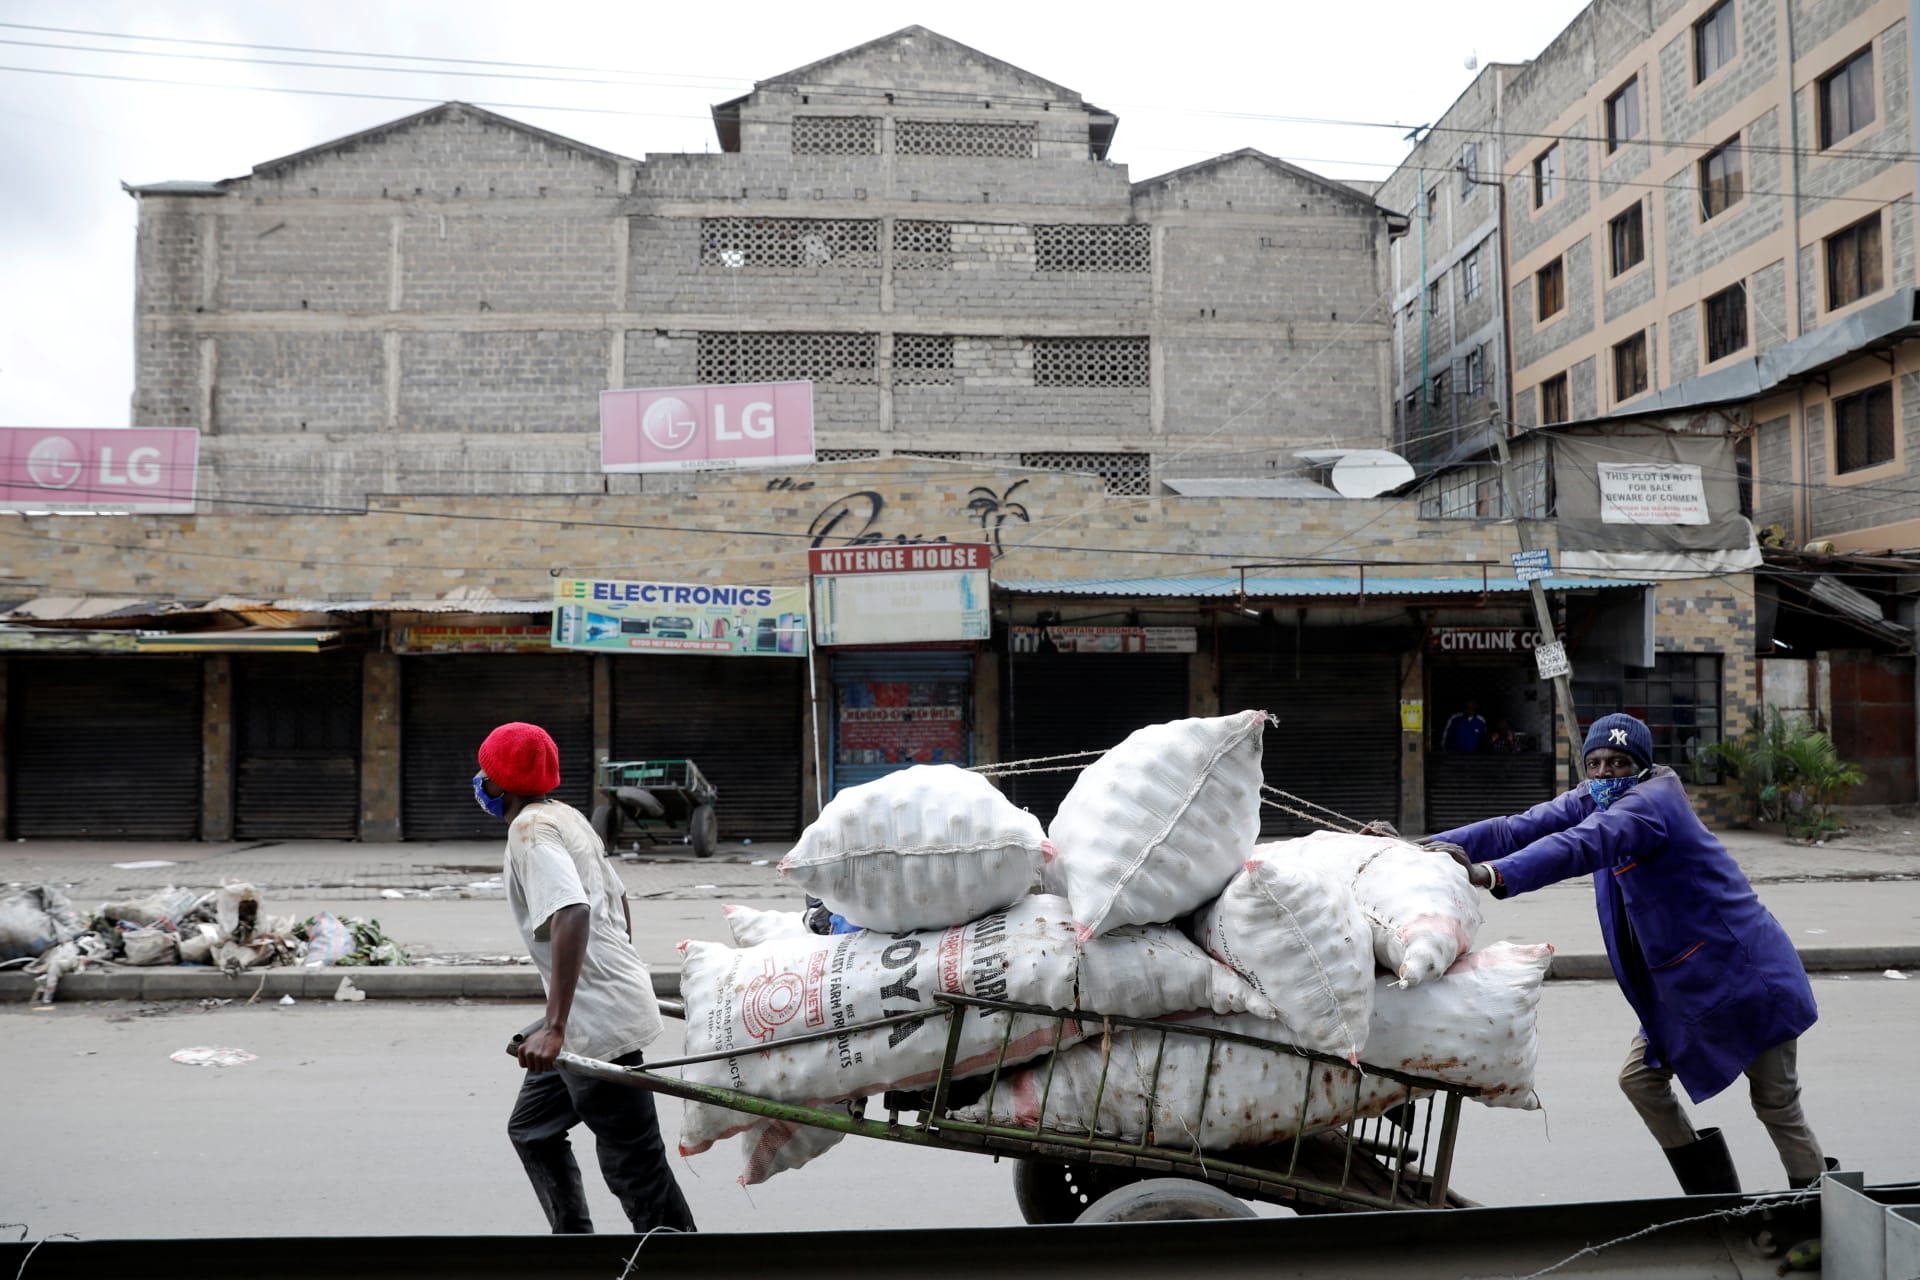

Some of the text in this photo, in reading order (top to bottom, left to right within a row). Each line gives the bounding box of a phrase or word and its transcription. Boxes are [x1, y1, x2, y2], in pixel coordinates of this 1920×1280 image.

[714, 402, 775, 440] LG
[100, 447, 161, 485] LG
[1605, 472, 1629, 481] THIS
[1631, 472, 1657, 481] PLOT
[1672, 473, 1693, 482] NOT
[1606, 493, 1698, 503] BEWARE OF CONMEN
[1628, 483, 1673, 492] FOR SALE
[821, 548, 977, 572] KITENGE HOUSE
[593, 582, 772, 607] ELECTRONICS
[1440, 631, 1517, 650] CITYLINK
[1608, 729, 1628, 745] NY
[944, 930, 960, 957] FARM
[830, 976, 842, 1011] FARM
[880, 931, 925, 1049] OYA
[808, 987, 820, 1022] NETT
[707, 1010, 715, 1041] THIKA
[715, 1009, 723, 1033] BOX
[846, 1003, 856, 1018] RICE
[854, 1051, 863, 1064] ETC
